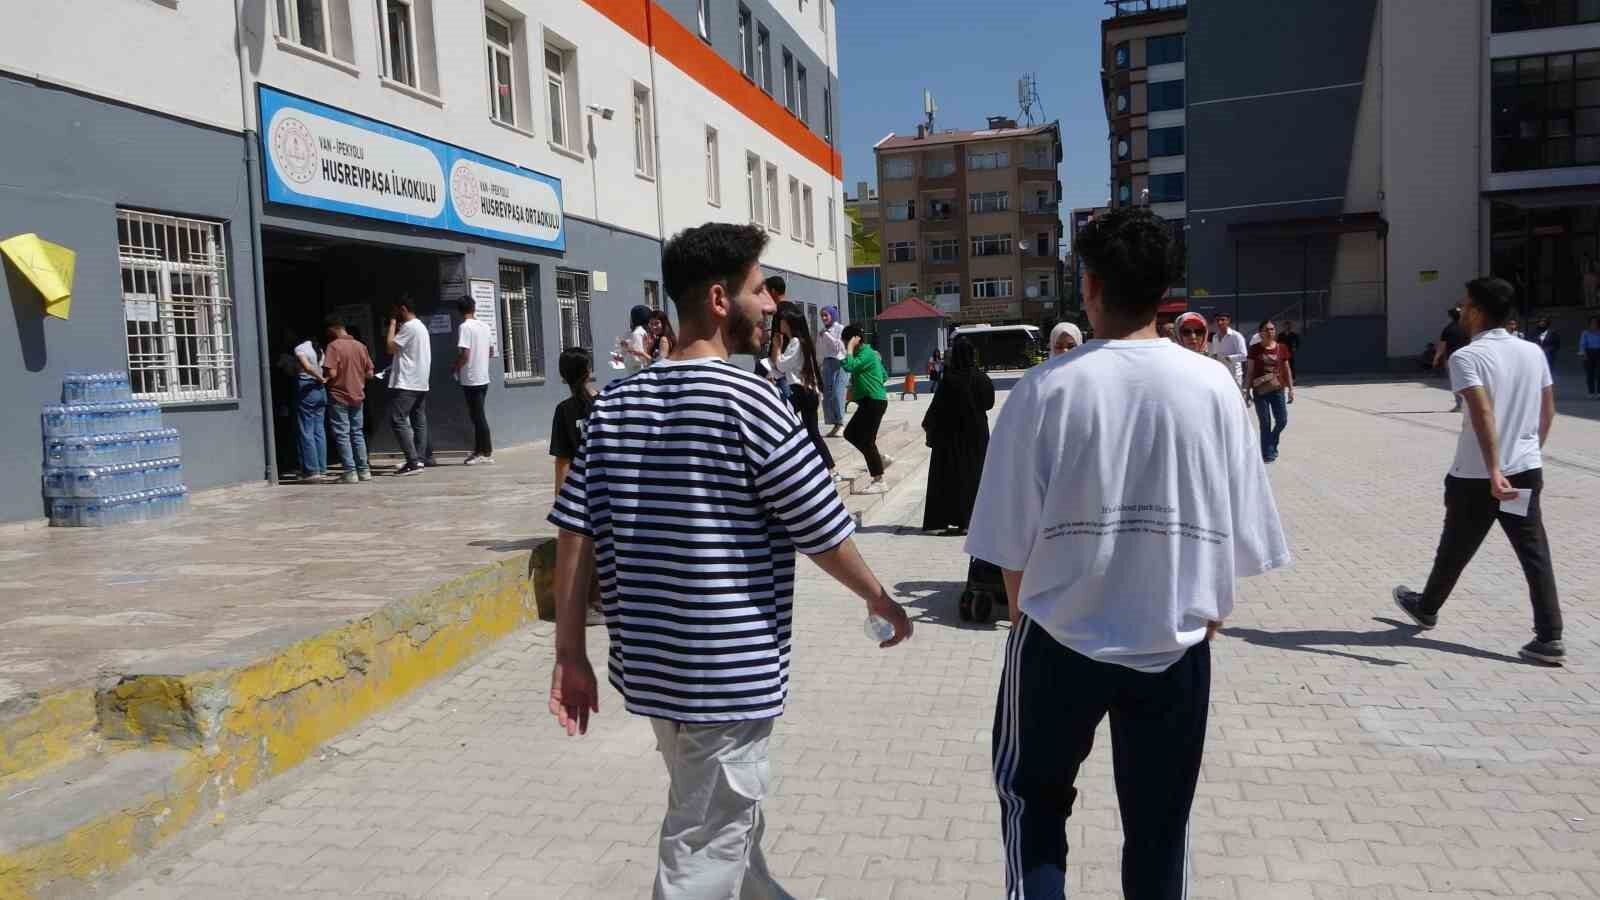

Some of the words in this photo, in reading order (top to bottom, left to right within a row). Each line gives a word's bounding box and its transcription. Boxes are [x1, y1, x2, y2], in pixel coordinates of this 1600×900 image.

[319, 136, 332, 152] VAN
[337, 138, 364, 160] İPEKYOLU
[321, 158, 392, 195] HUSREVPAŞA
[392, 168, 436, 203] İLKOKULU
[480, 196, 524, 224] HUSREVPAŞA
[525, 207, 560, 230] ORTAOKULU
